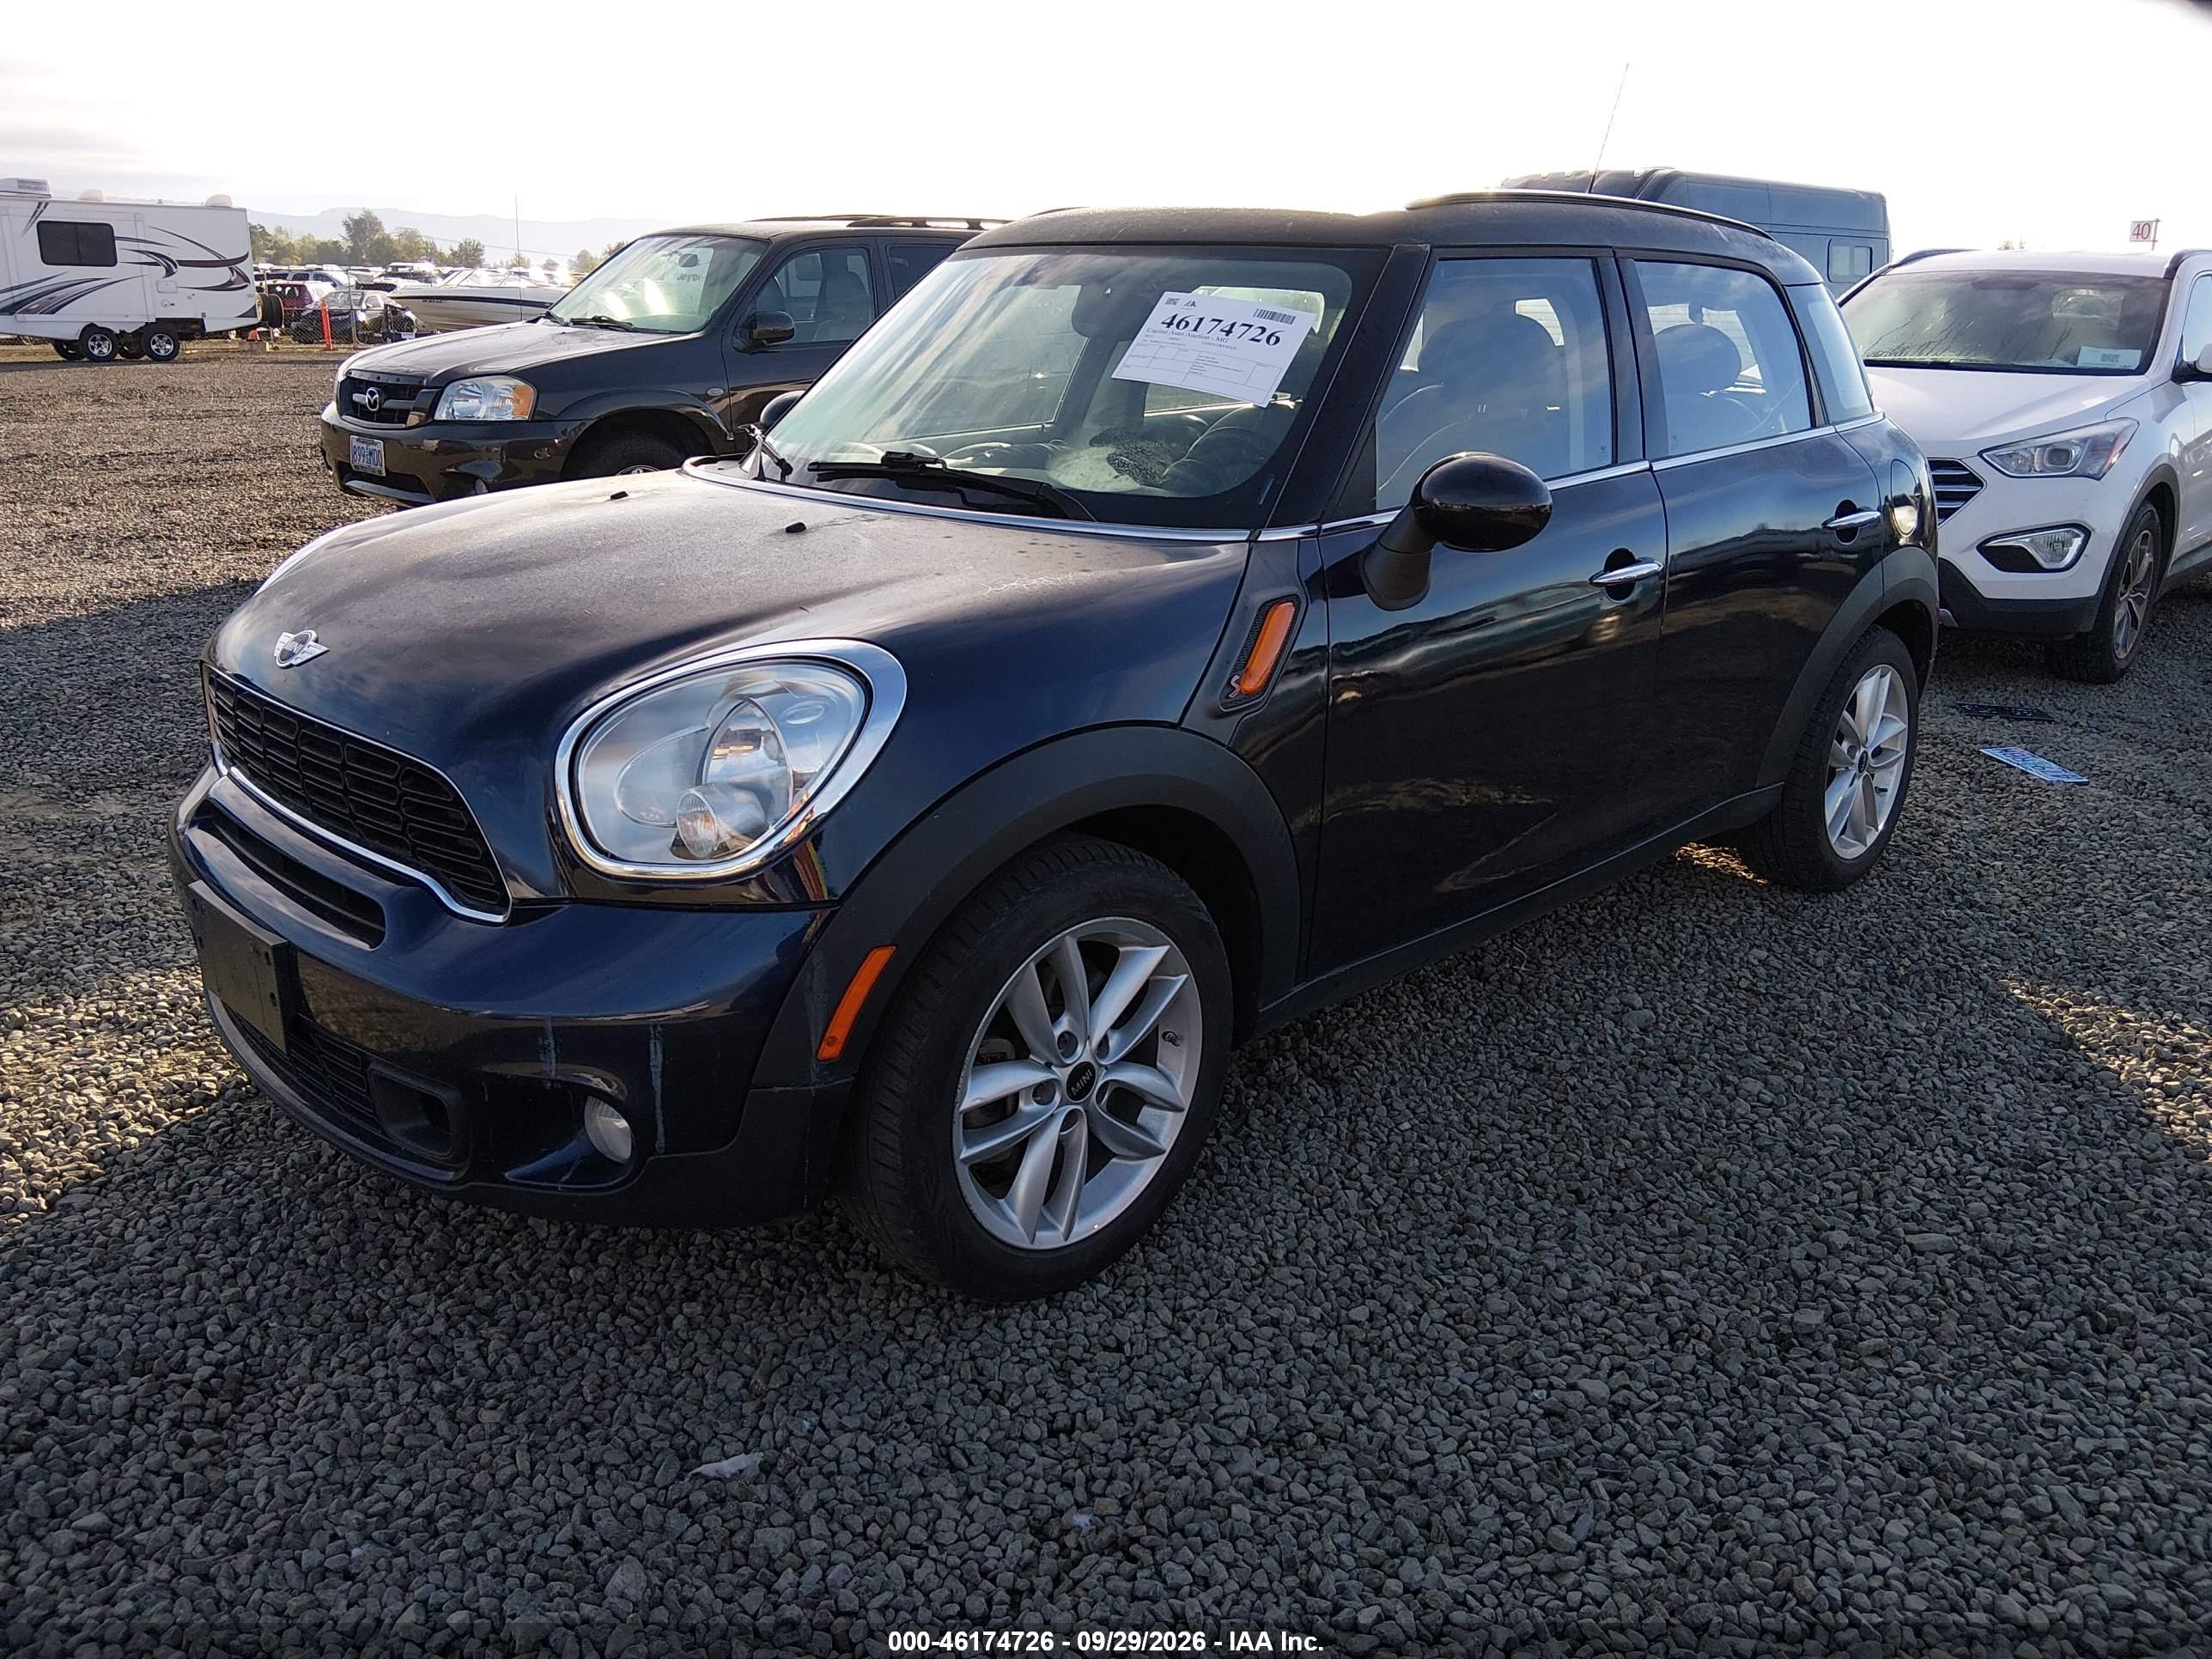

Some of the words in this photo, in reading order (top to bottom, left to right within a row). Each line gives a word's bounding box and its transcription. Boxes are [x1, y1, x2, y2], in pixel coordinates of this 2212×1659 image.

[2131, 222, 2151, 240] 40
[1160, 313, 1285, 346] 46174726
[1185, 331, 1210, 340] Auction
[1070, 1068, 1093, 1096] MINI
